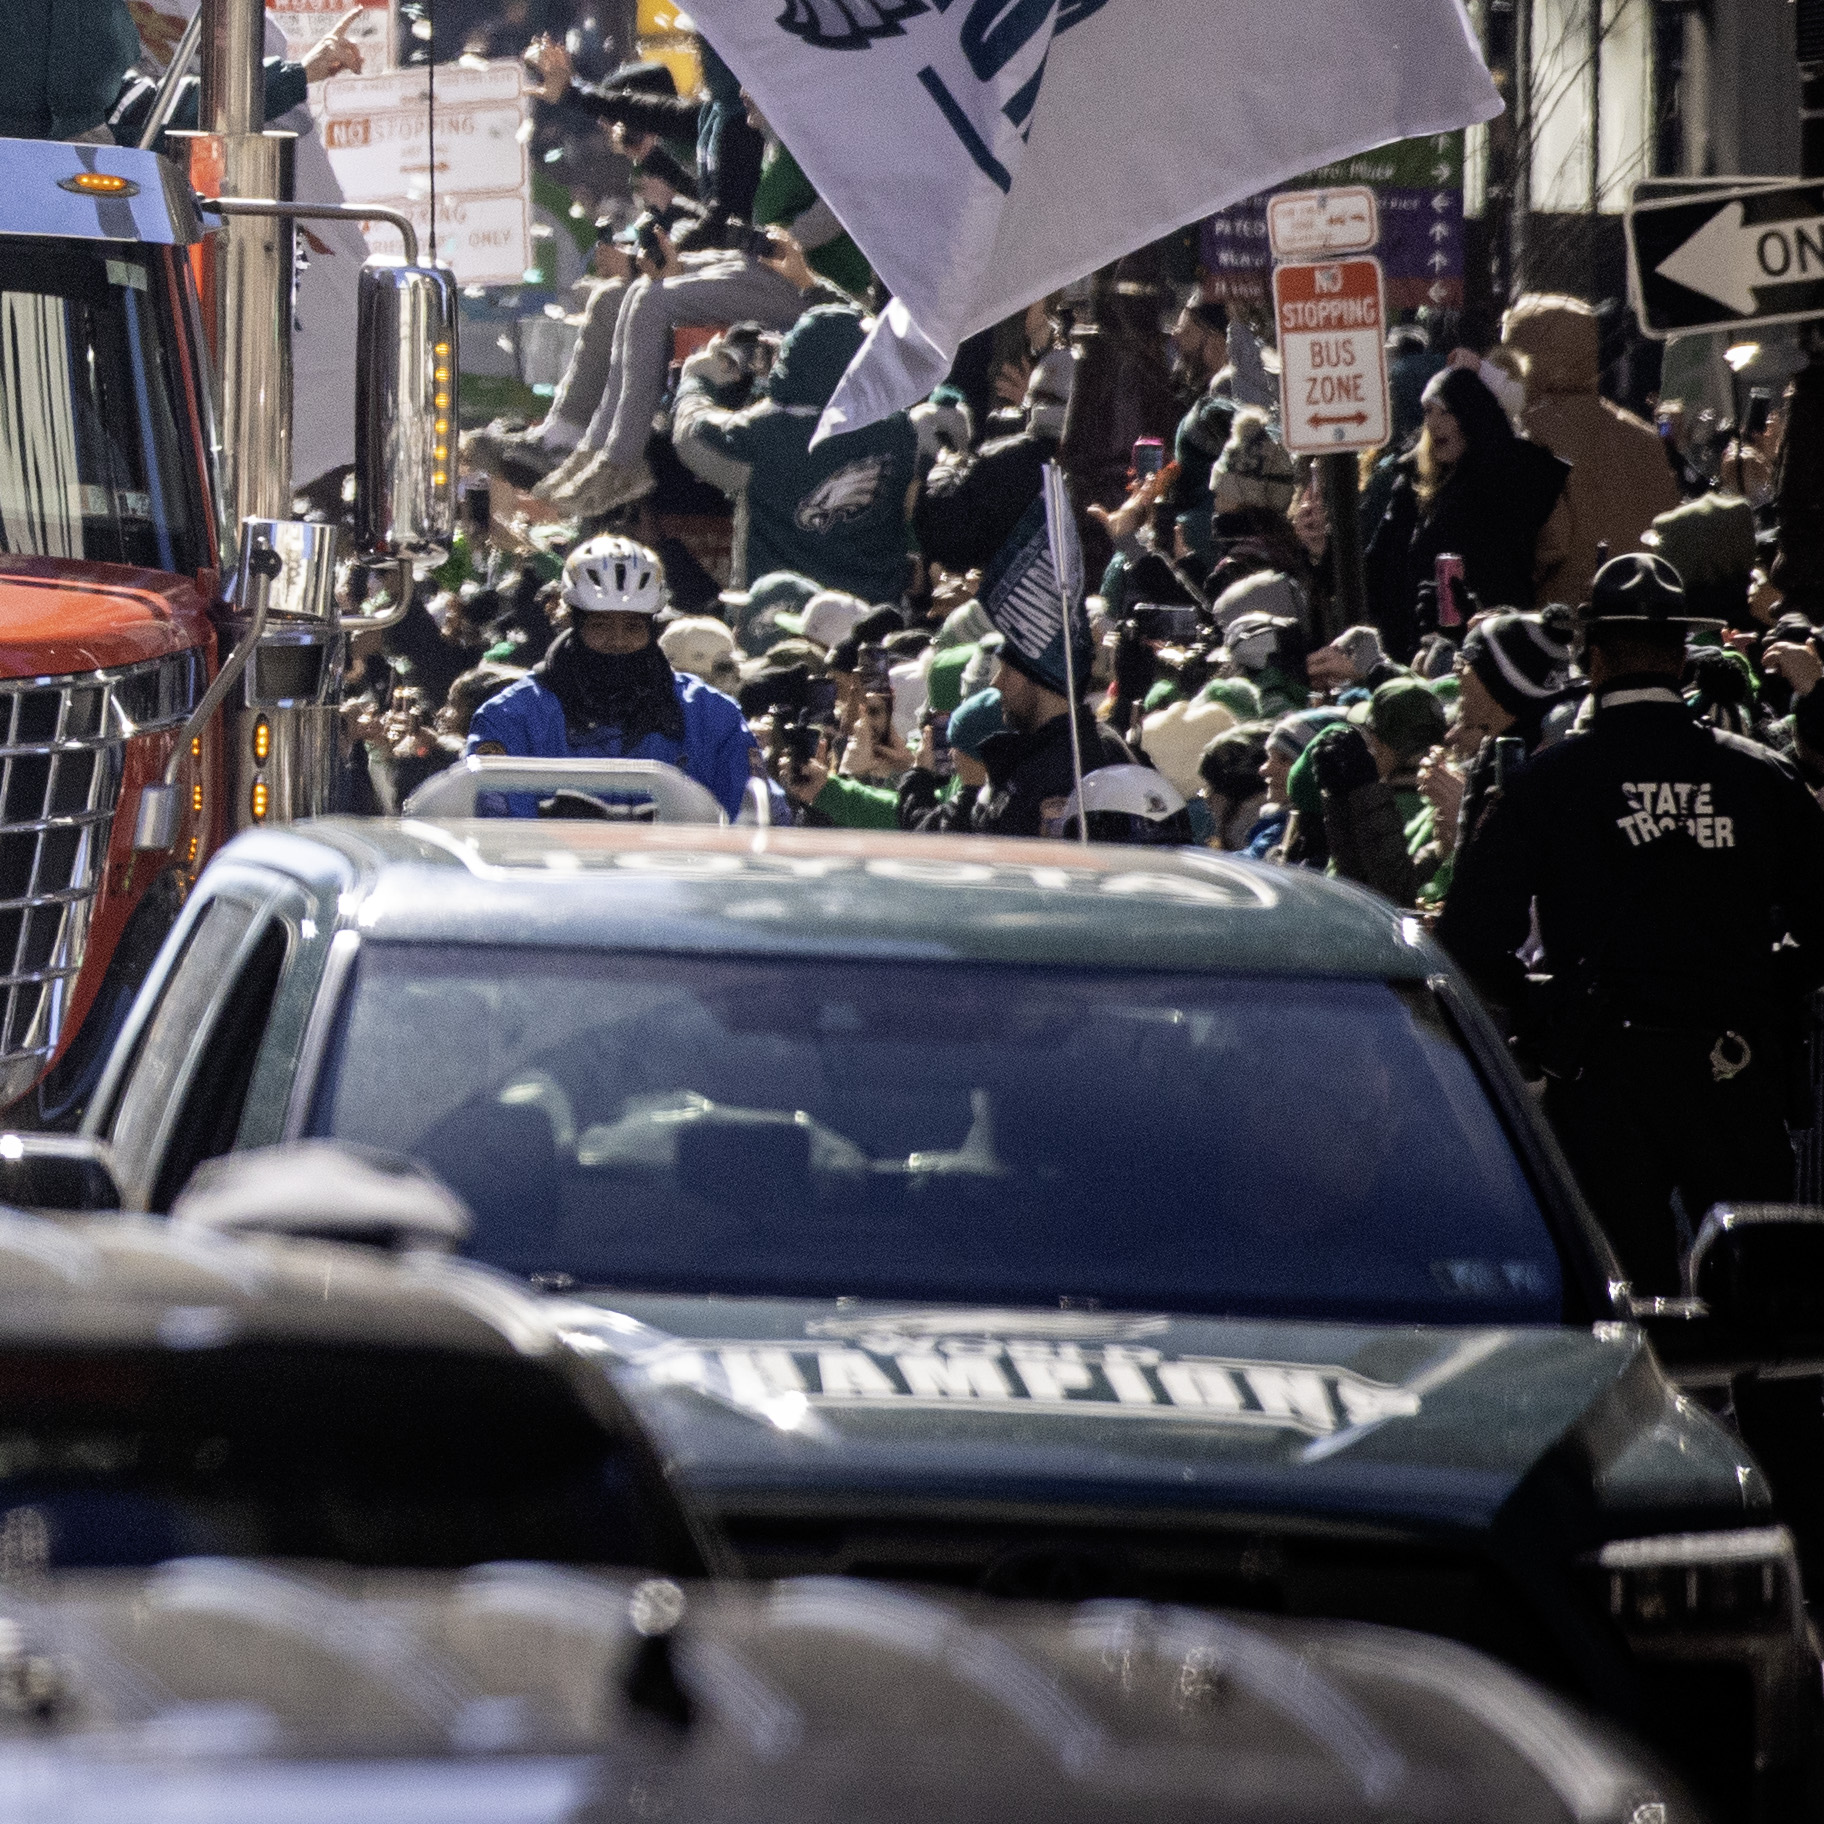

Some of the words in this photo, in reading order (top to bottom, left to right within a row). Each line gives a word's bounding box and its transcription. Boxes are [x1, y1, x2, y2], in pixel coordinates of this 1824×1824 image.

[334, 122, 366, 147] NO
[1314, 267, 1344, 293] NO
[1281, 296, 1376, 328] STOPPING
[1309, 337, 1356, 368] BUS
[1305, 375, 1366, 406] ZONE
